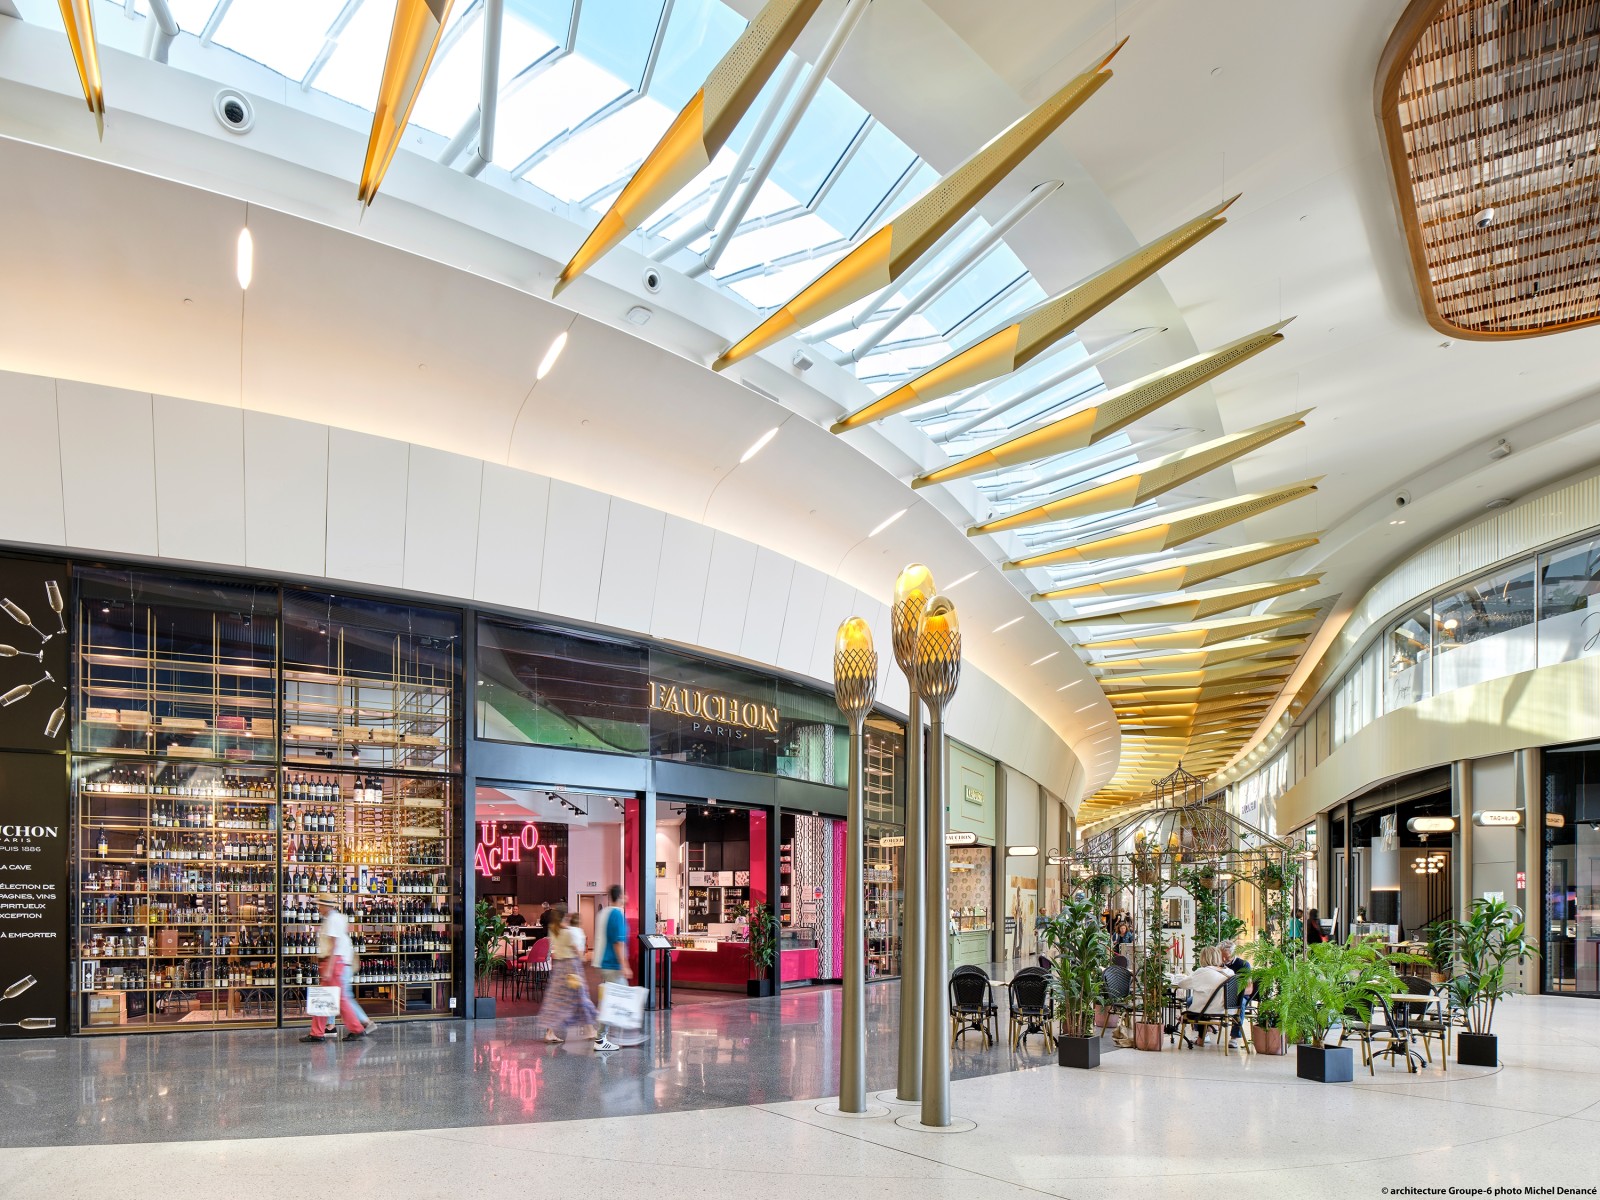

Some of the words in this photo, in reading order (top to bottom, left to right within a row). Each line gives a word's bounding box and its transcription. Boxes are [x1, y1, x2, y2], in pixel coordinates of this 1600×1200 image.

[647, 681, 779, 732] FAUCHON
[692, 721, 742, 739] PARIS
[0, 825, 59, 838] CHON
